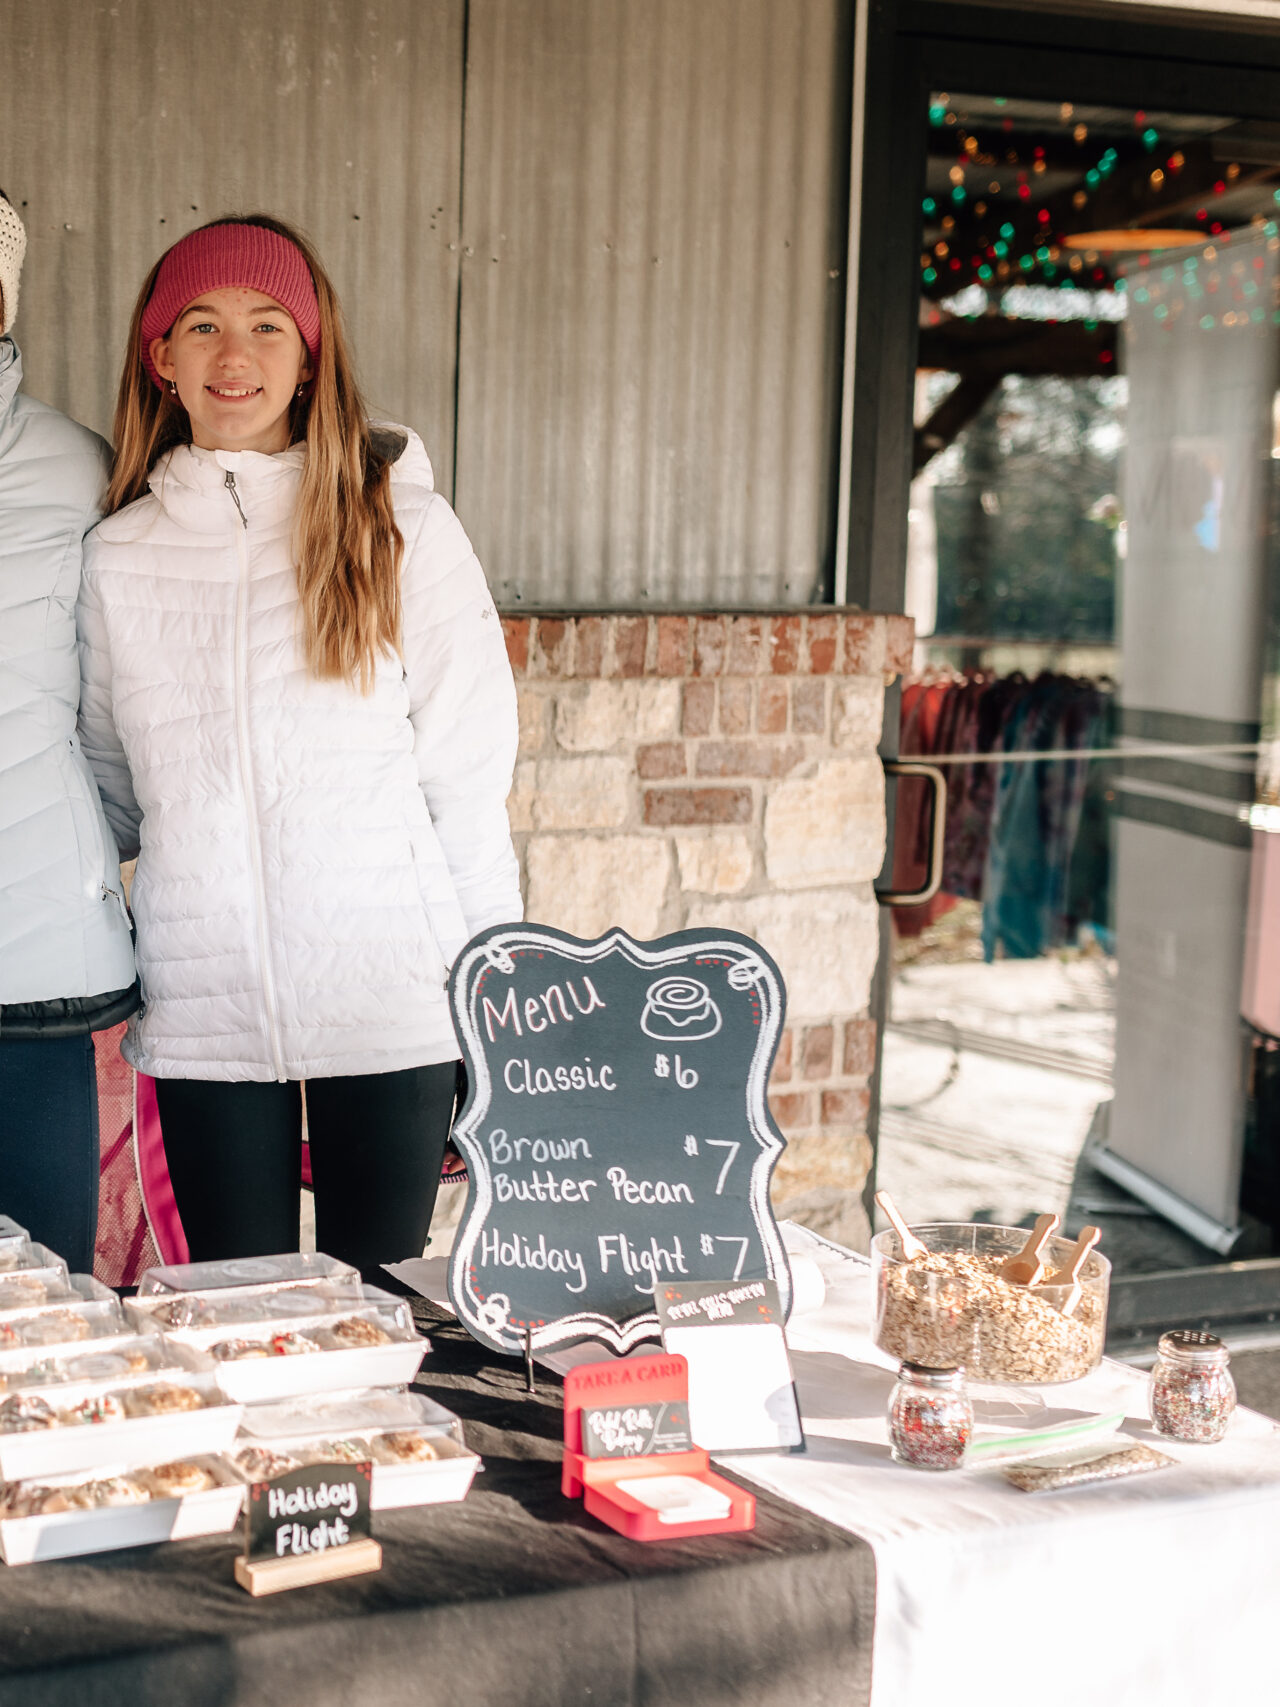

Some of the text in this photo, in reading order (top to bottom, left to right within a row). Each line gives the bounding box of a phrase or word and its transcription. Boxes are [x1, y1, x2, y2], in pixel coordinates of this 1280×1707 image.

[482, 976, 606, 1042] Menu
[504, 1053, 699, 1095] Classic $6
[488, 1129, 593, 1164] Brown
[494, 1167, 694, 1204] Butter Pecan
[481, 1228, 749, 1294] Holiday Flight $7
[573, 1361, 683, 1390] TAKE A CARD
[268, 1481, 359, 1518] Holiday
[276, 1516, 350, 1556] Flight
